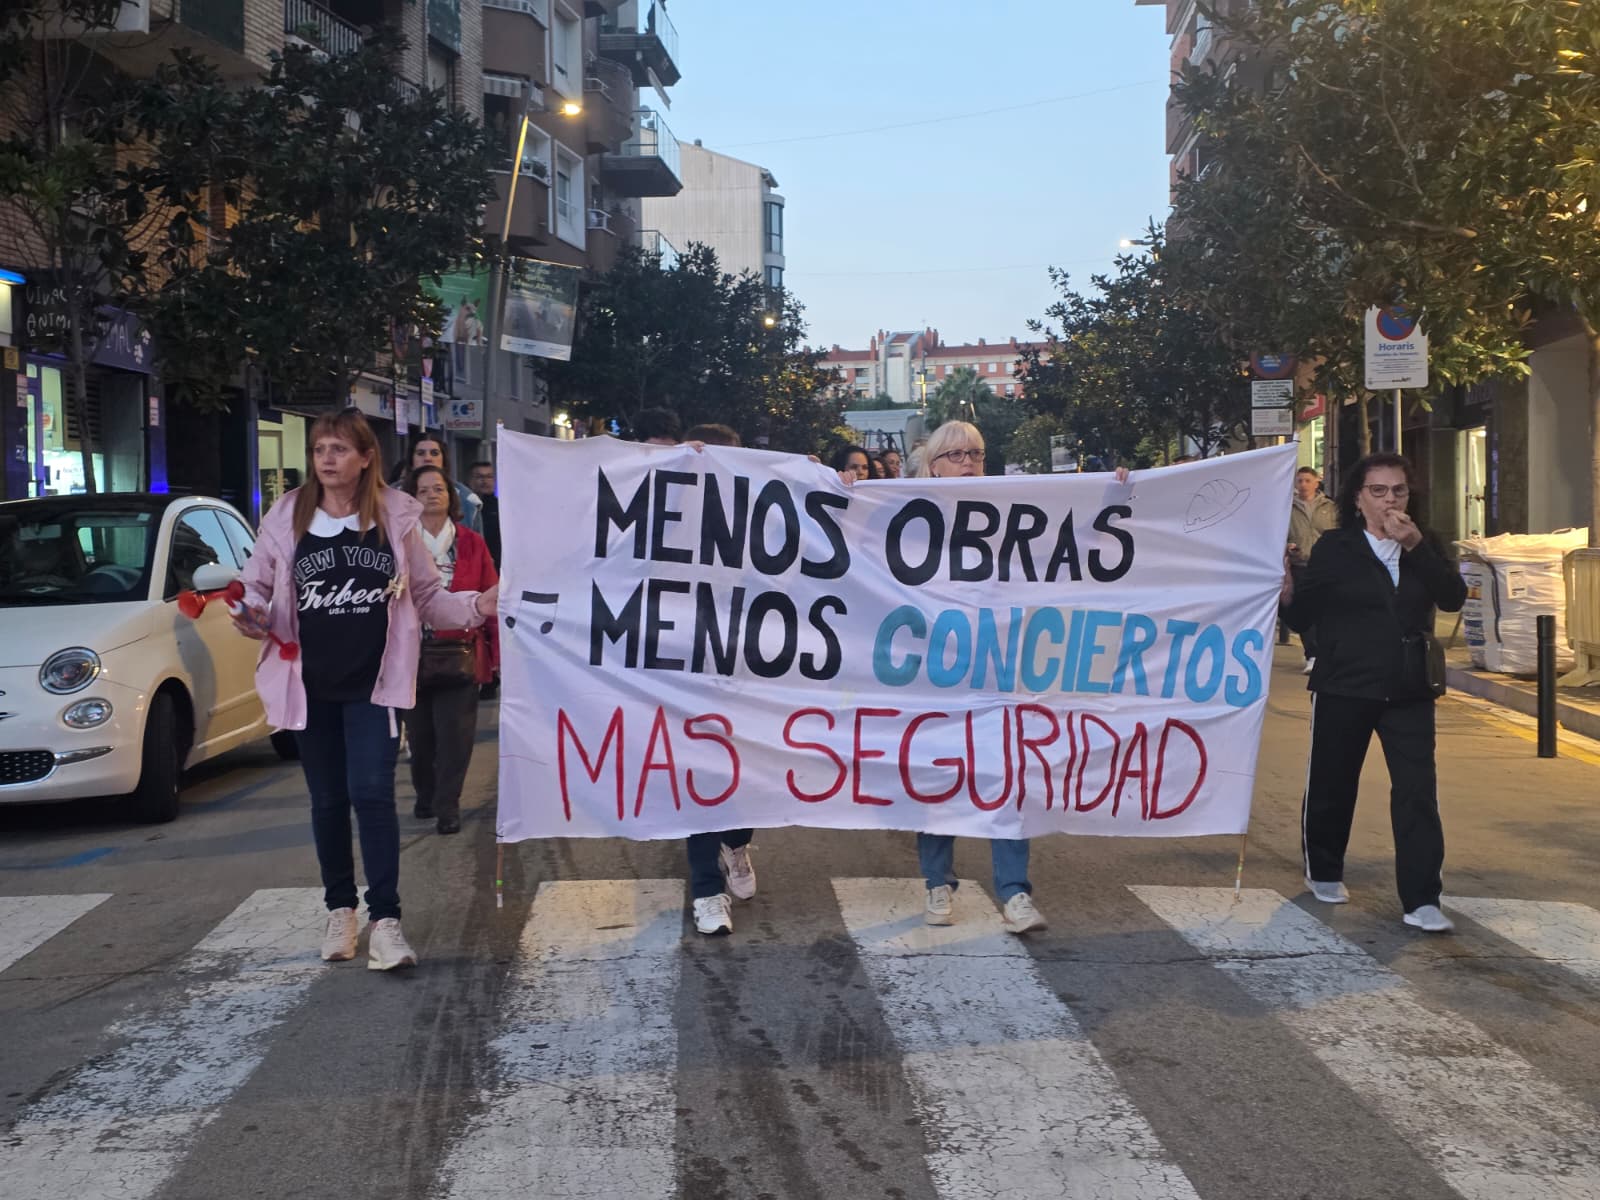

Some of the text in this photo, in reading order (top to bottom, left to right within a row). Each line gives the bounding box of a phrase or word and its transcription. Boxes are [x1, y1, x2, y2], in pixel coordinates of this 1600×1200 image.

[1378, 341, 1415, 352] Horaris
[342, 545, 394, 578] YOR
[594, 465, 1135, 586] MENOS OBRAS
[589, 578, 1264, 707] MENOS CONCIERTOS
[557, 703, 1208, 822] MAS SEGURIDAD
